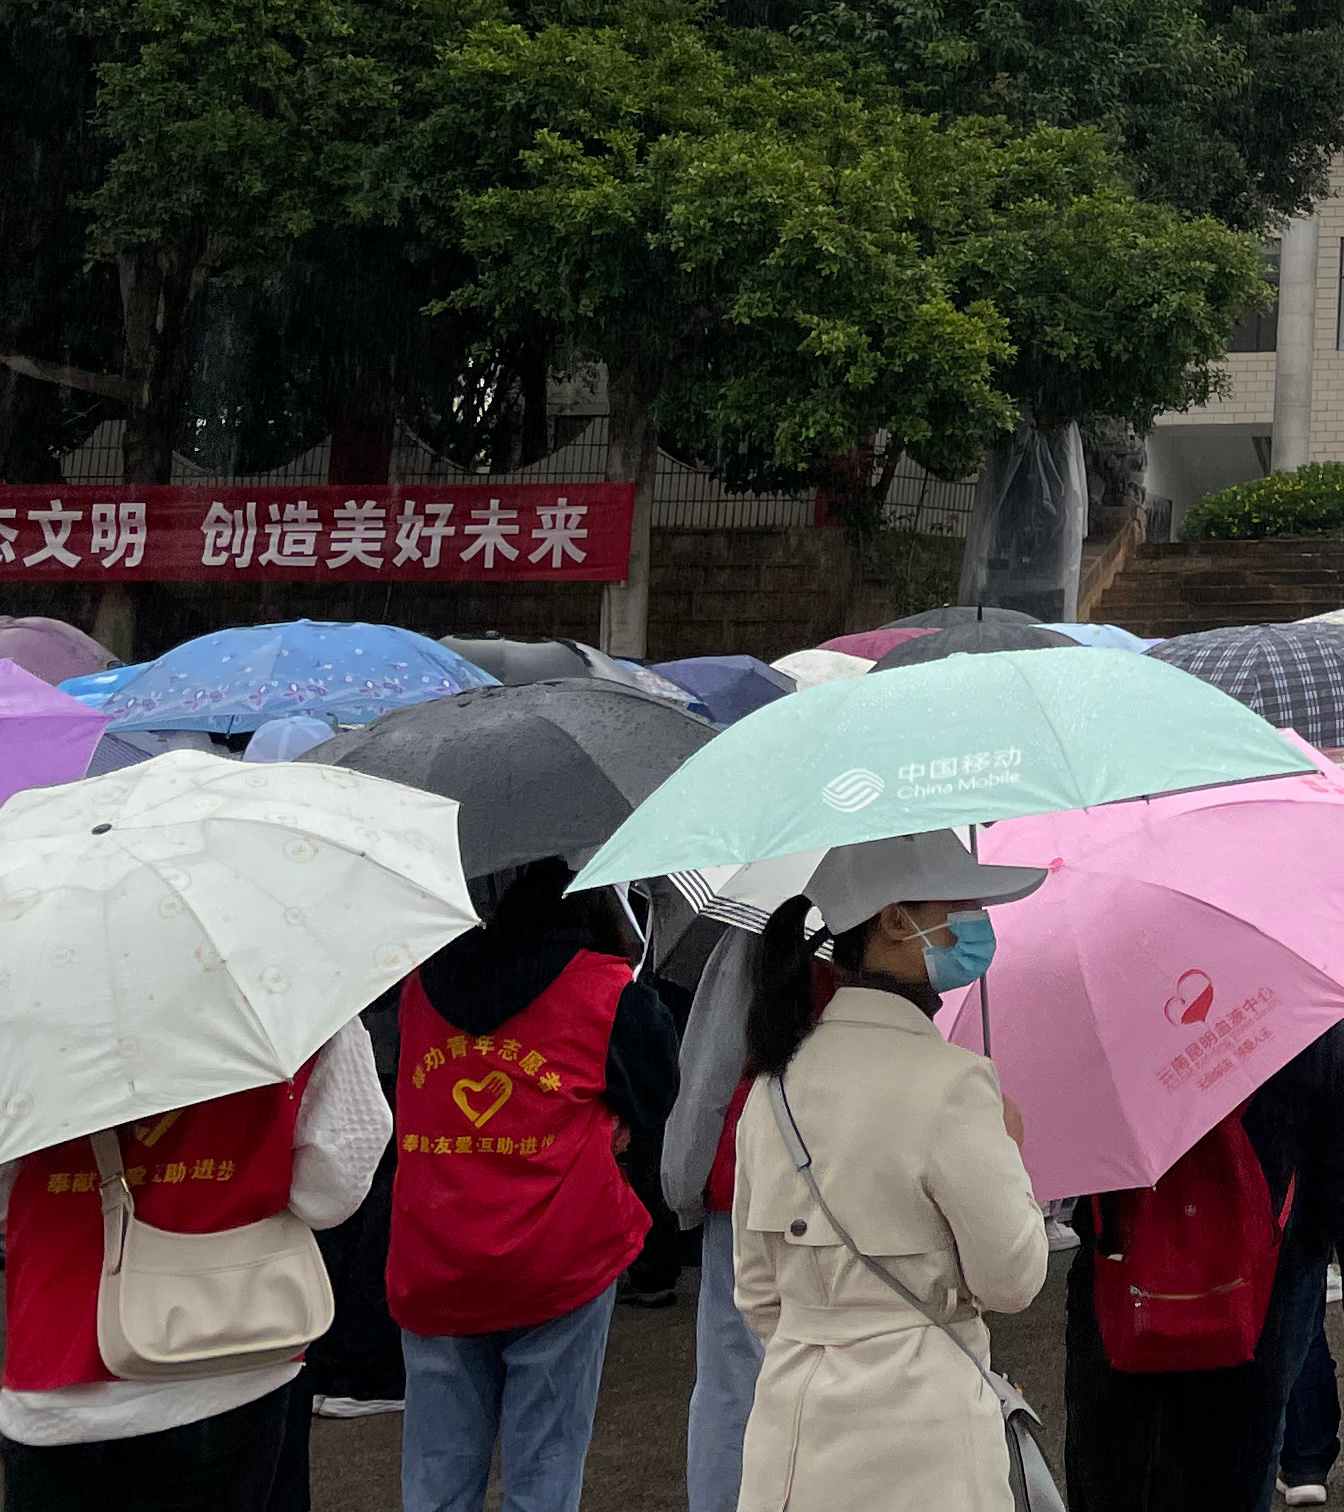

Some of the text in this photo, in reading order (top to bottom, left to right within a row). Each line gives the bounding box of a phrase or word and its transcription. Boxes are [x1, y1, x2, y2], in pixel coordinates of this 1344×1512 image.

[200, 497, 588, 570] 创造美好未来
[898, 746, 1021, 783] 中国移动
[897, 770, 1020, 799] China Mobile
